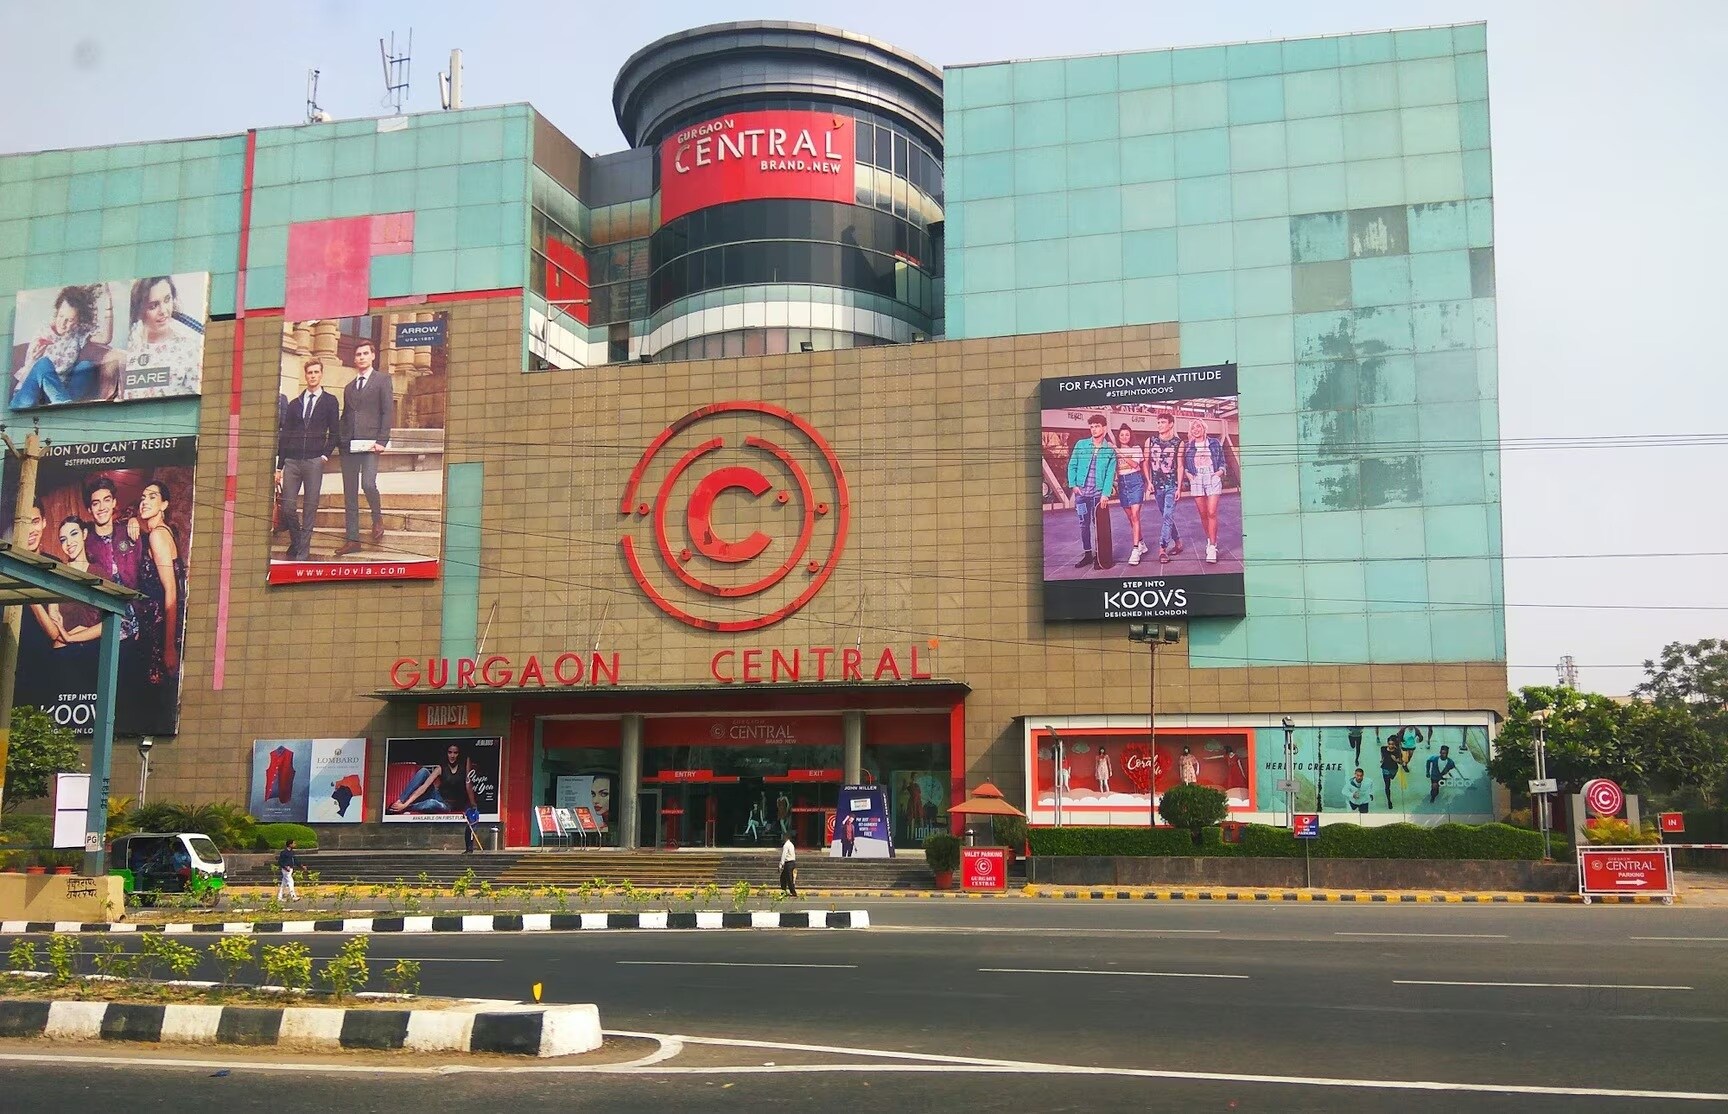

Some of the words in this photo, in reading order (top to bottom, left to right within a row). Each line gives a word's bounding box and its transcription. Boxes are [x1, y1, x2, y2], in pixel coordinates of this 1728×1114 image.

[677, 119, 735, 144] GURGAON
[674, 128, 843, 174] CENTRAL
[401, 326, 439, 335] ARROW
[126, 371, 168, 386] BARE
[1059, 382, 1081, 392] FOR
[1084, 377, 1134, 390] FASHION
[1137, 374, 1167, 385] WITH
[1170, 370, 1222, 384] ATTITUDE
[1105, 387, 1174, 398] #STEPINTOKOOVS
[75, 442, 98, 454] YOU
[102, 441, 138, 453] CAN'T
[141, 437, 178, 449] RESIST
[64, 455, 126, 467] #STEPINTOKOOVS
[1104, 588, 1187, 609] KOOVS
[390, 652, 620, 690] GURGAON
[711, 645, 932, 683] CENTRAL
[427, 705, 469, 726] BARISTA
[730, 725, 795, 739] CENTRAL
[1307, 763, 1343, 771] CREATE
[86, 835, 97, 844] PG
[1605, 861, 1657, 871] CENTRAL
